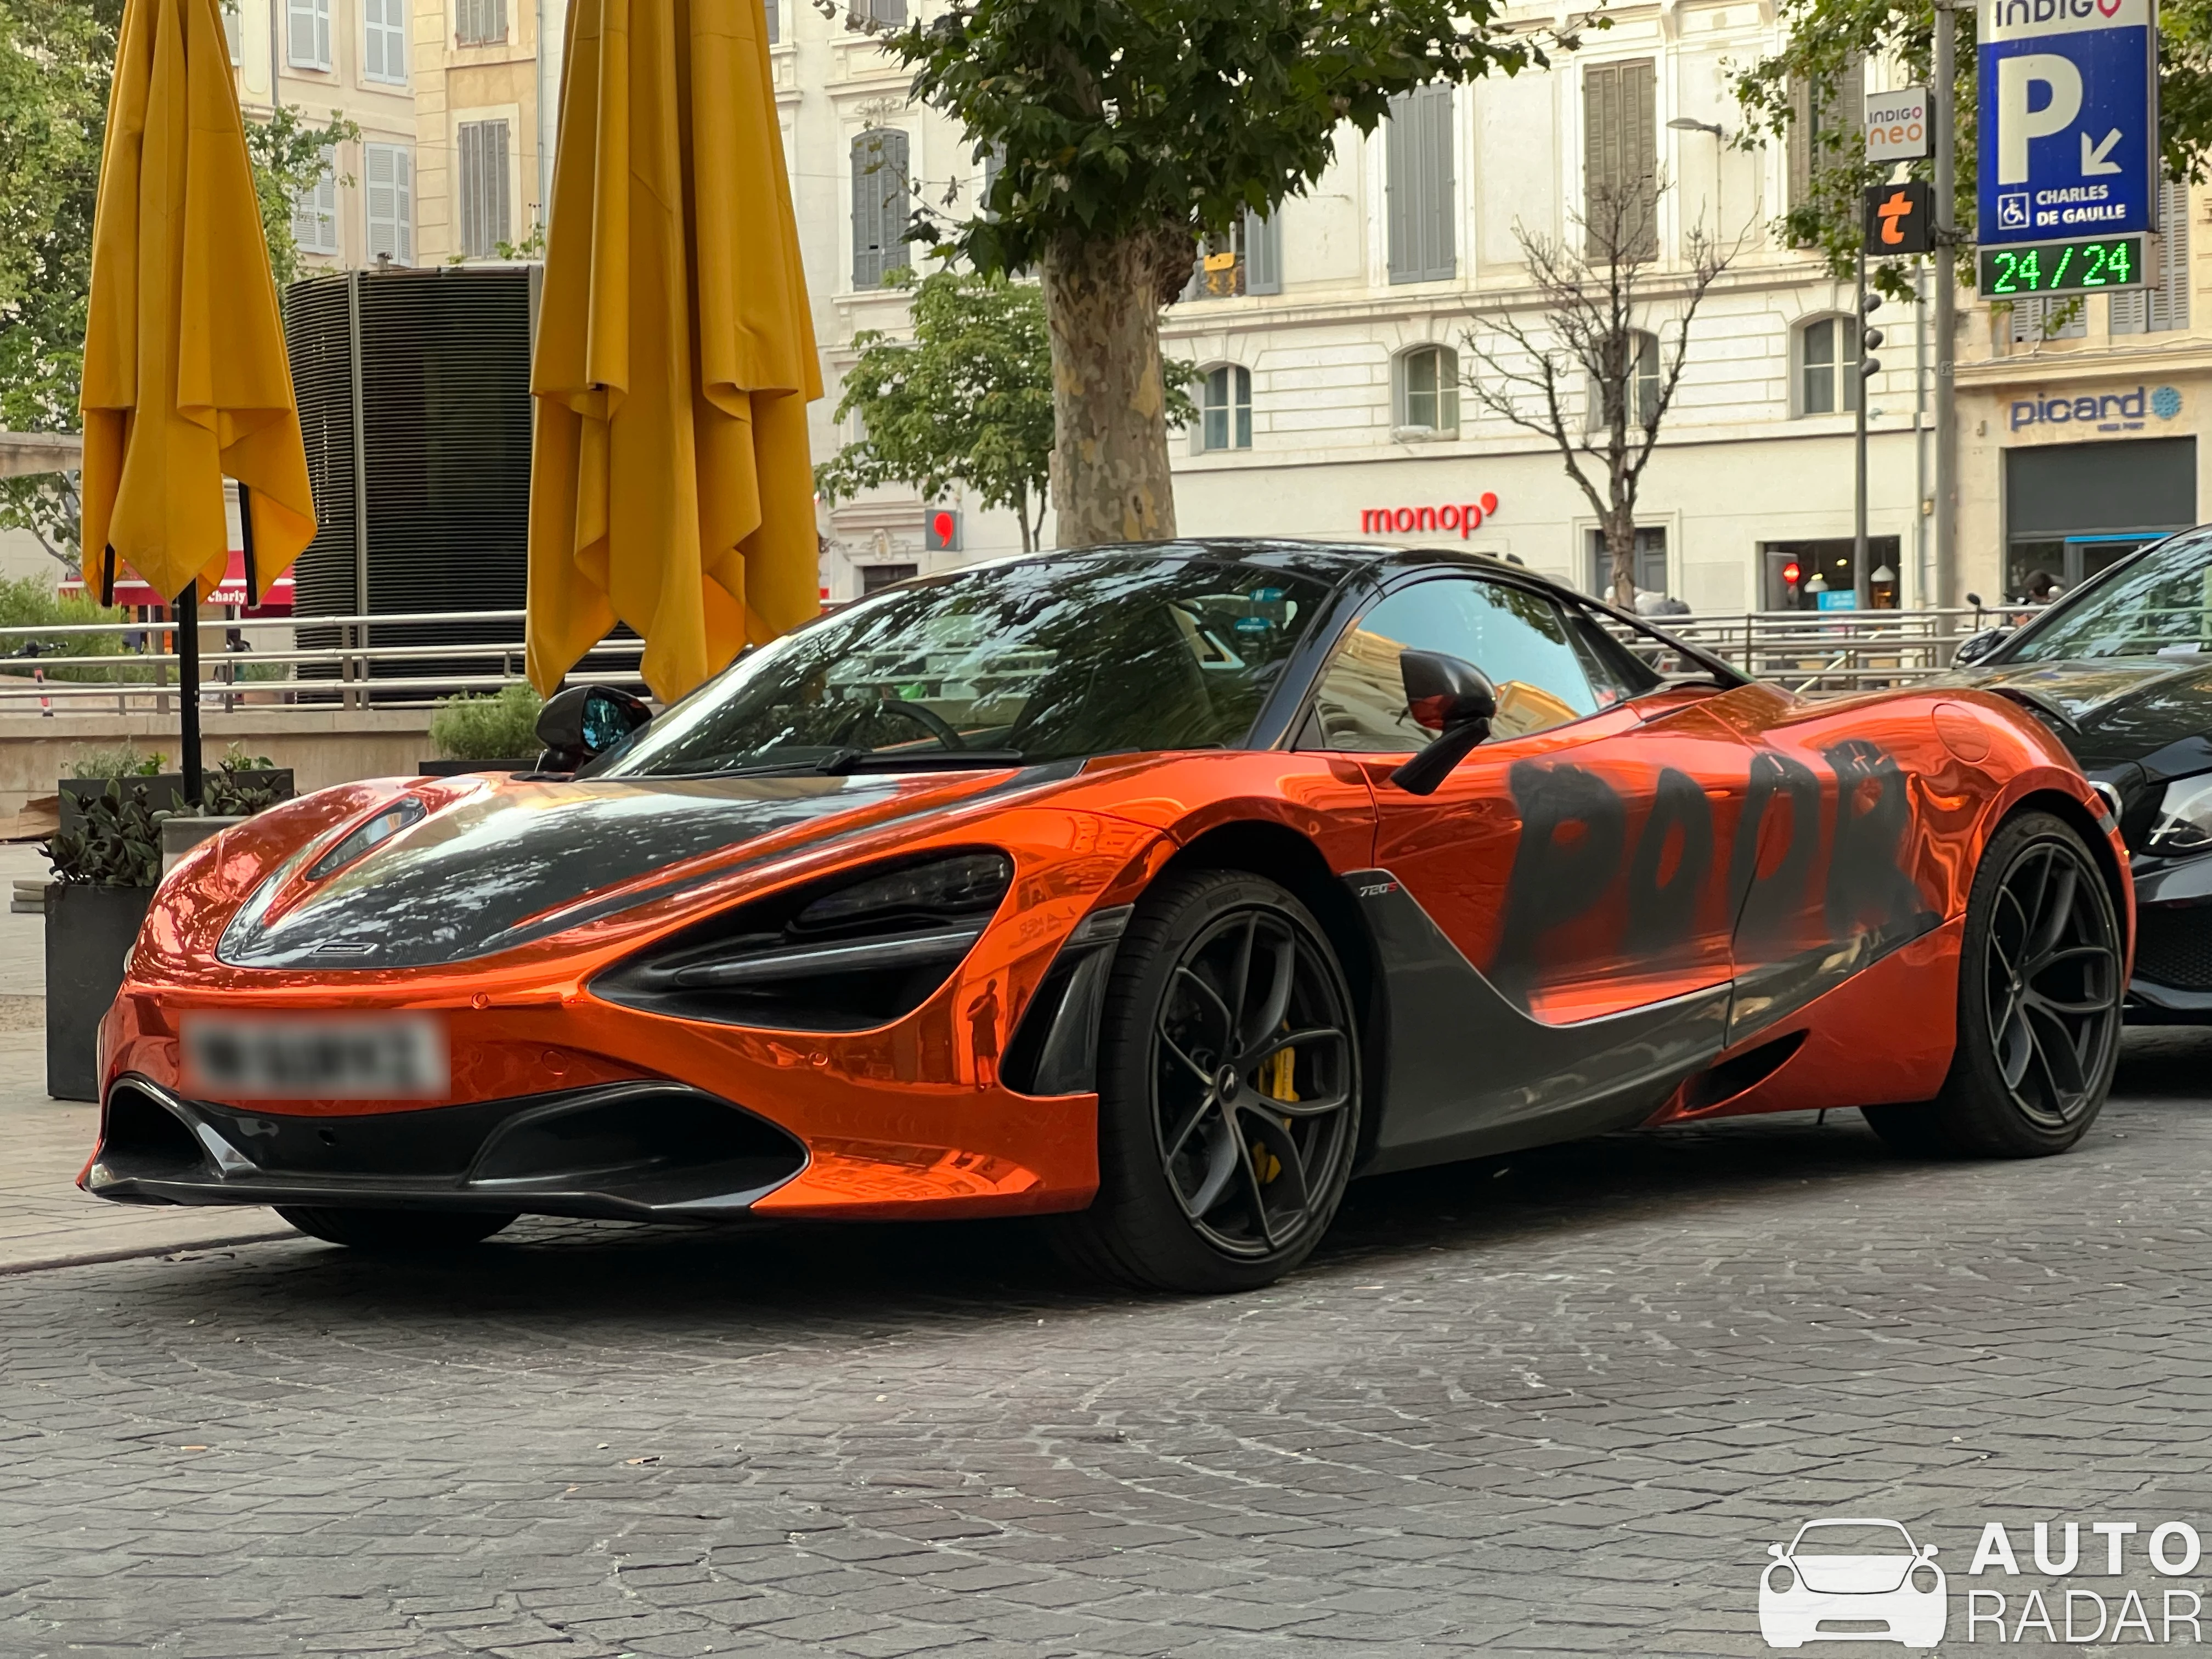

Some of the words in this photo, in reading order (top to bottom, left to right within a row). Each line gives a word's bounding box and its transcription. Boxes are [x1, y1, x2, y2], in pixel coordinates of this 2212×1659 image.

[1869, 106, 1922, 123] INDIGO
[1998, 54, 2083, 185] P
[1869, 123, 1922, 145] neo
[2036, 184, 2109, 206] CHARLES
[2036, 211, 2059, 227] DE
[2062, 204, 2126, 224] GAULLE
[2011, 386, 2145, 432] picard
[207, 589, 246, 604] Charly
[1359, 881, 1398, 897] 720S
